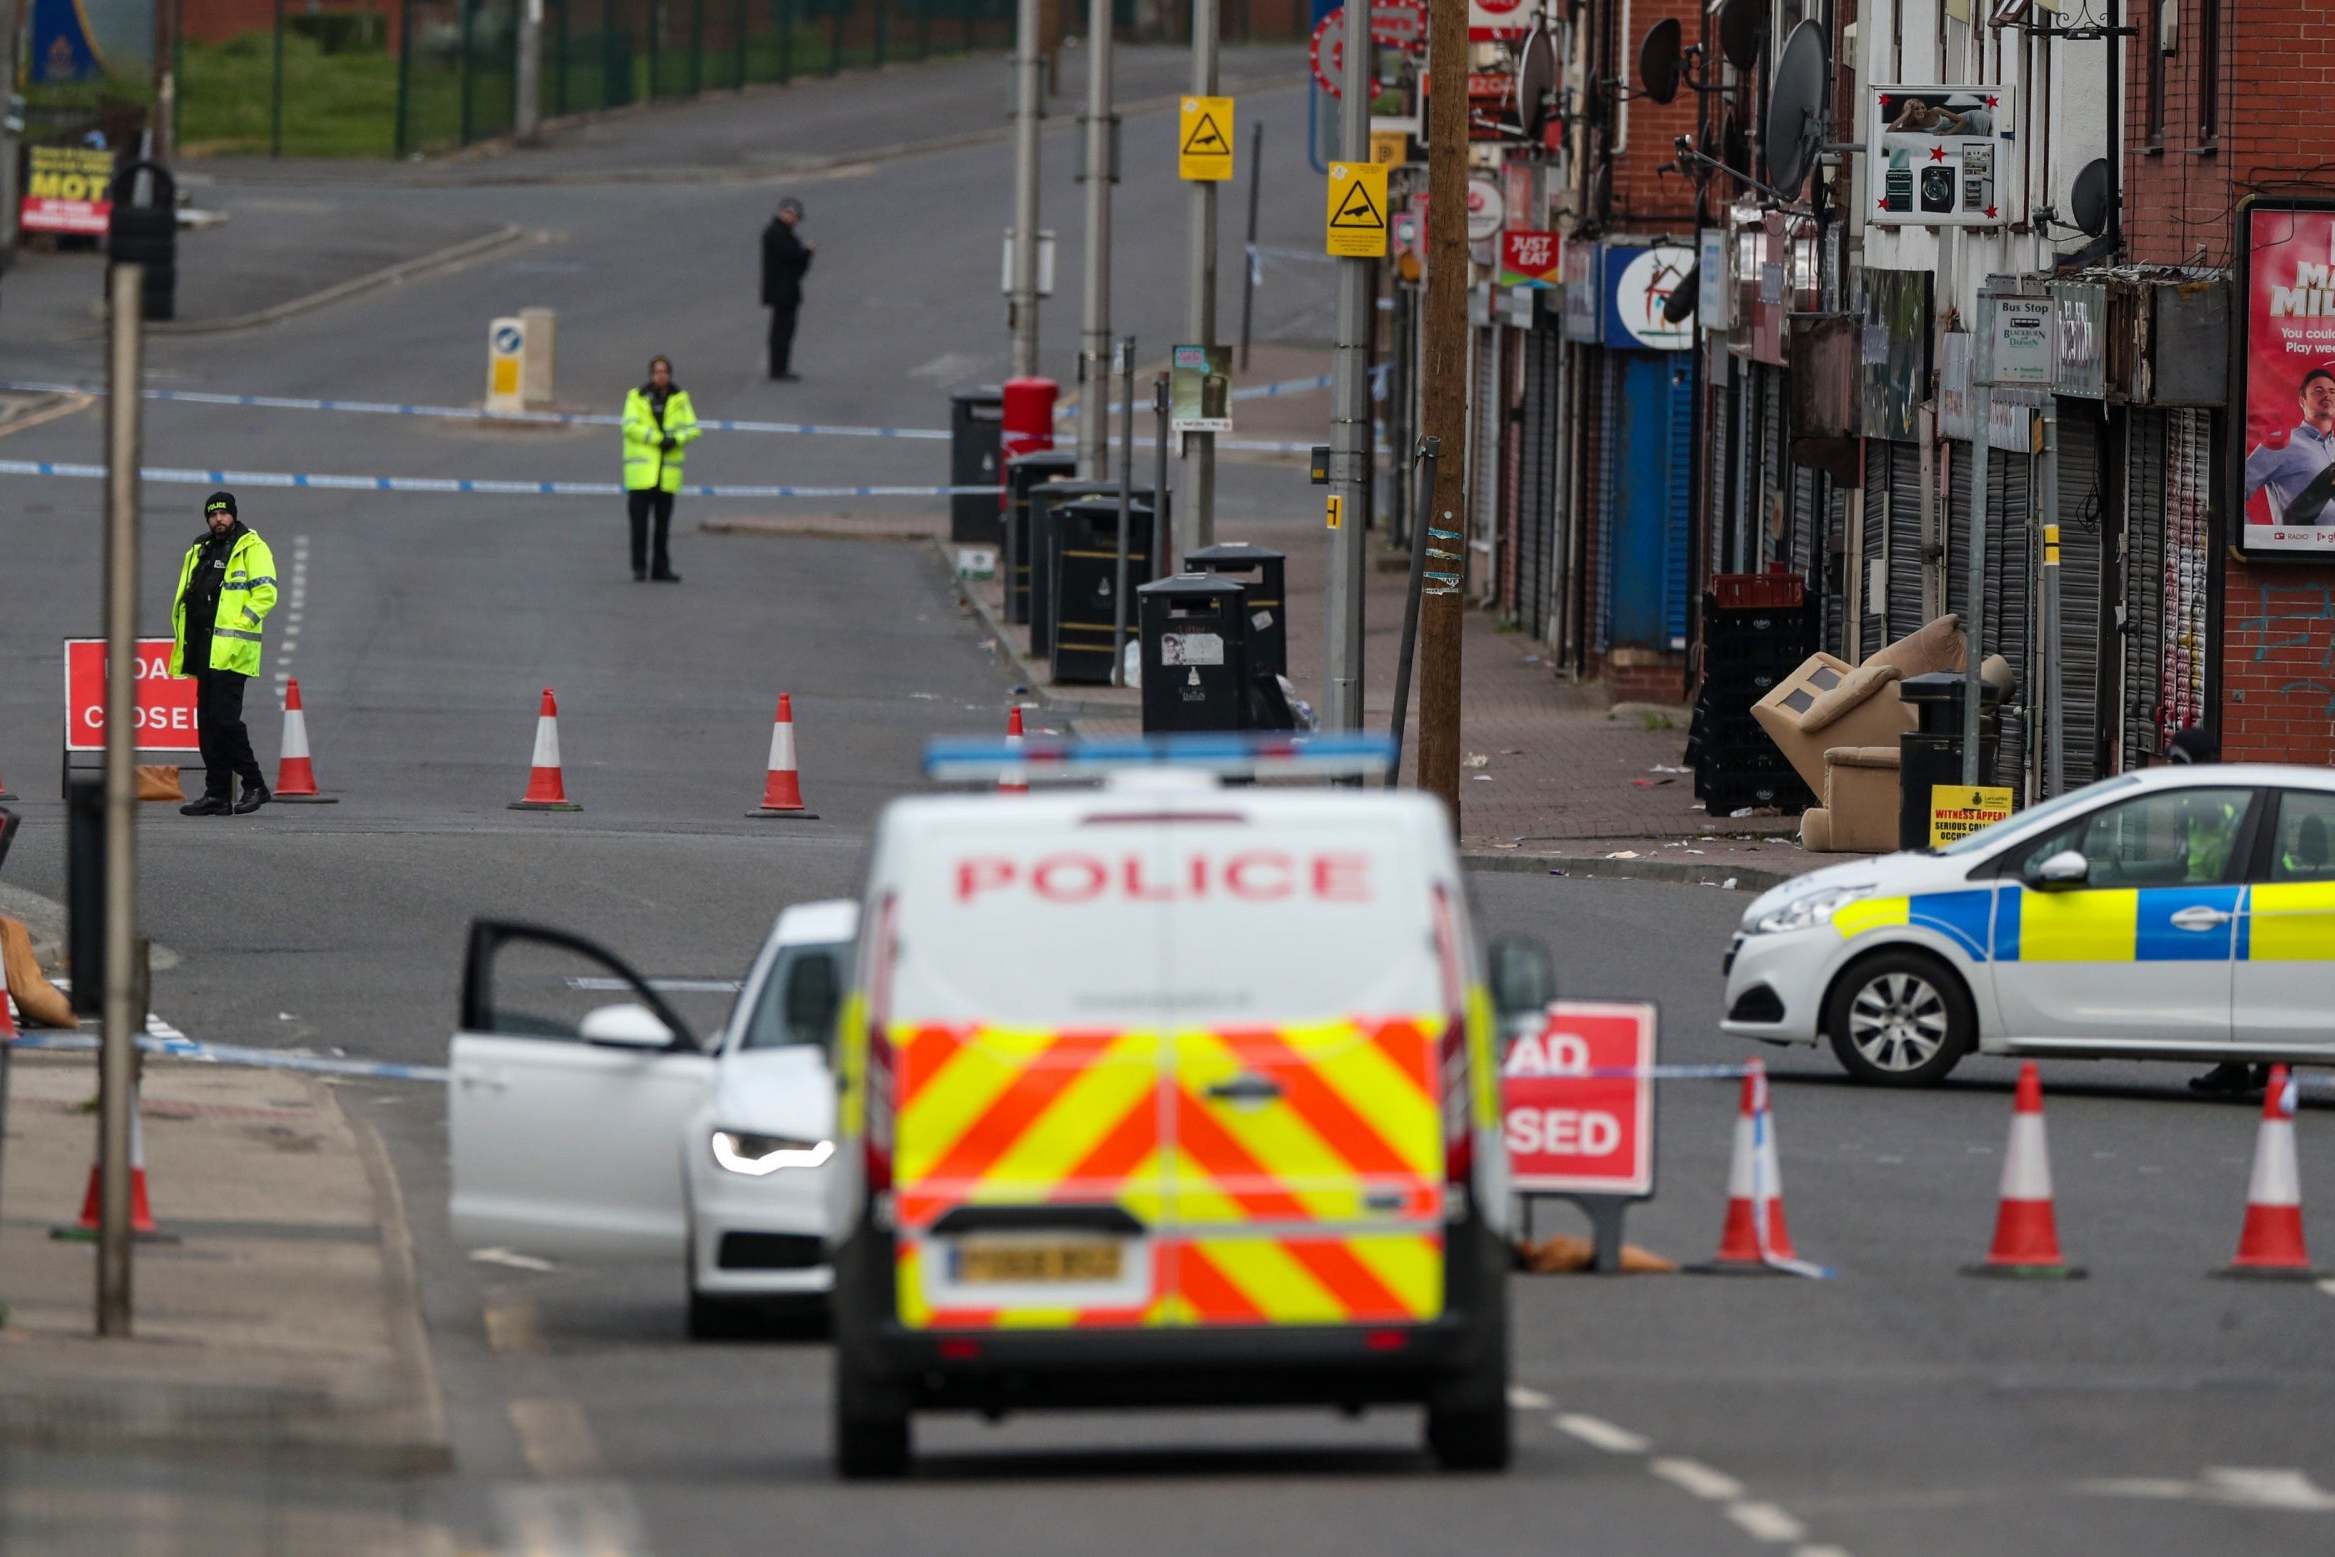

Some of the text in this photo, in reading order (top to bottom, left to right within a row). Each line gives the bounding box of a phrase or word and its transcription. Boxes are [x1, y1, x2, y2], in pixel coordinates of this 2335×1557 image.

[30, 171, 110, 202] MOT
[1511, 235, 1552, 253] JUST
[1518, 249, 1551, 266] EAT
[2295, 261, 2335, 291] M
[2002, 302, 2049, 315] Bus Stop
[2281, 327, 2303, 339] You
[2286, 342, 2312, 355] Play
[207, 502, 226, 512] POLICE
[105, 657, 188, 680] OA
[84, 705, 199, 729] COSE
[1935, 809, 1975, 820] WITNESS
[1935, 821, 1990, 832] SERIOUS COL
[1940, 832, 1970, 841] OCCUR
[954, 850, 1371, 905] POLICE
[1504, 1032, 1589, 1077] AD
[1505, 1107, 1621, 1157] SED
